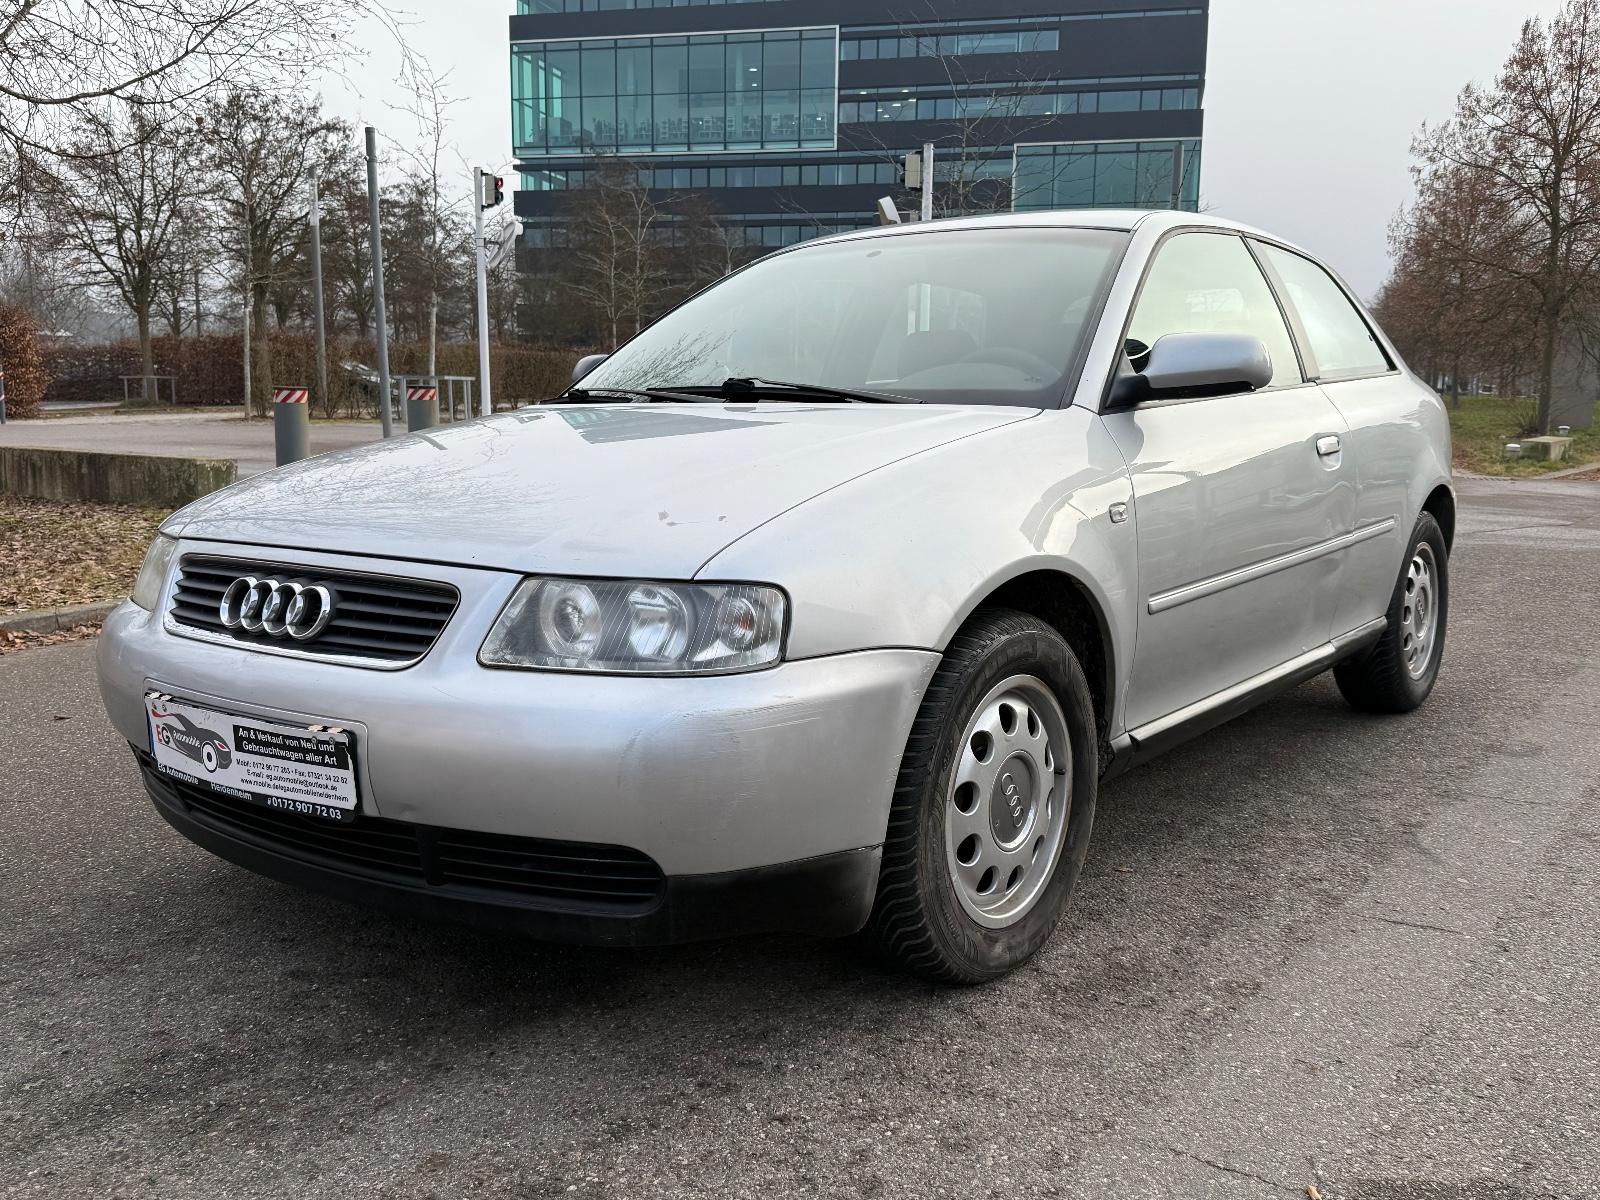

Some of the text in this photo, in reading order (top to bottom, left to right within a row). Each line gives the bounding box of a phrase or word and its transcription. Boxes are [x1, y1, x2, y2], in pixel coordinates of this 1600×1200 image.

[156, 724, 171, 745] EG
[239, 727, 249, 738] An
[250, 730, 256, 739] &
[257, 731, 283, 744] Verkauf
[284, 739, 299, 748] von
[319, 743, 335, 752] und
[242, 741, 338, 766] Gebrauchtwagen aller Art
[253, 761, 265, 770] 0172
[332, 775, 340, 783] 22
[158, 763, 342, 820] EG Automobile Heidenheim 0172 907 72 03
